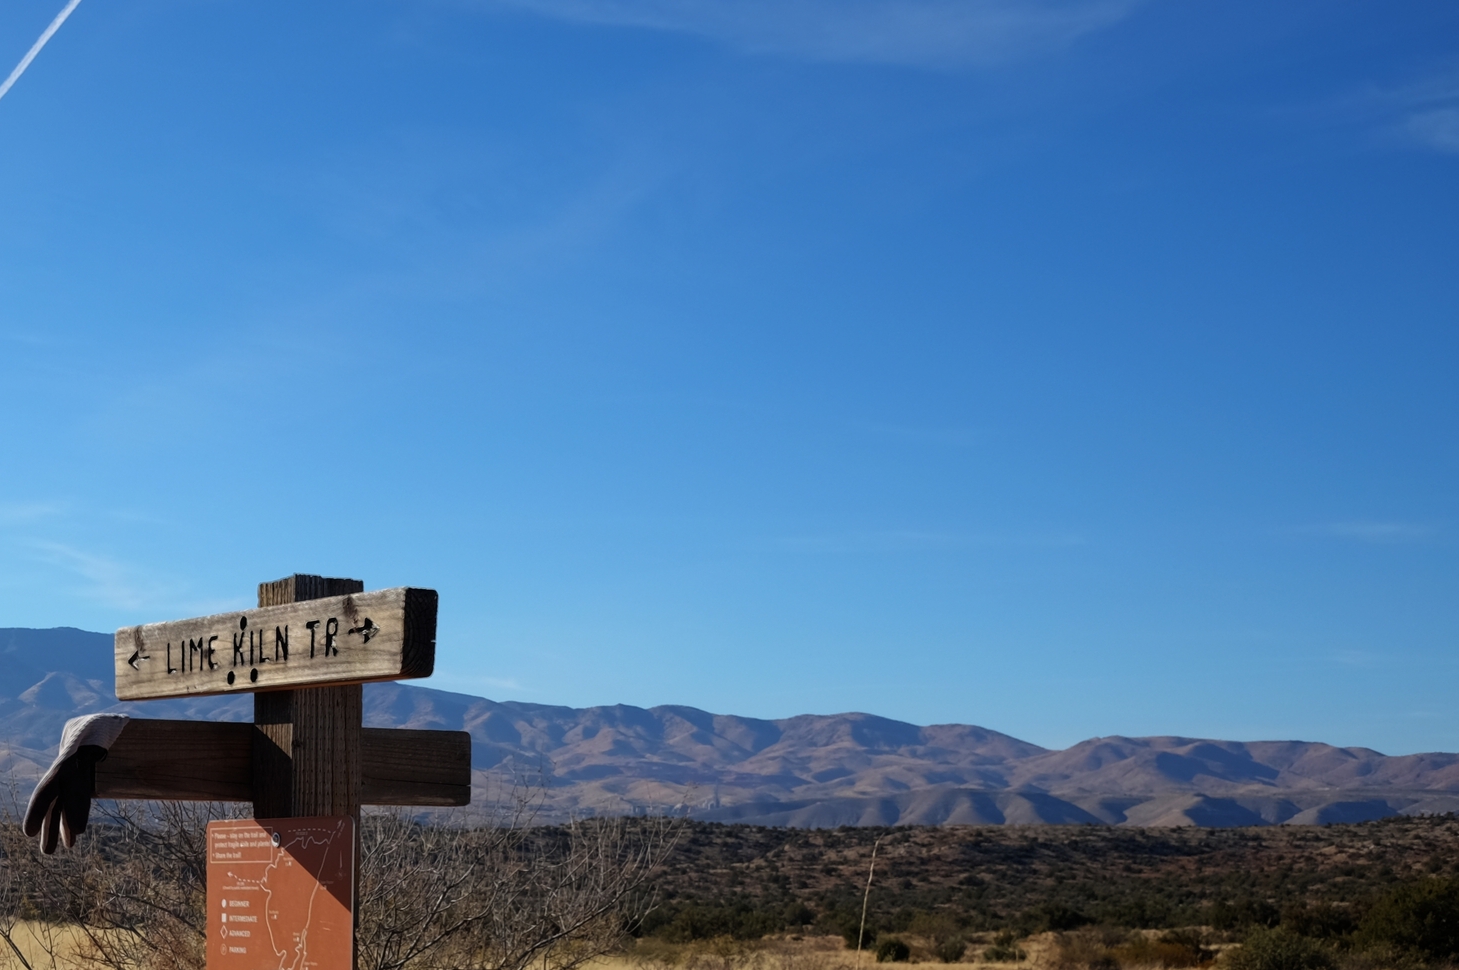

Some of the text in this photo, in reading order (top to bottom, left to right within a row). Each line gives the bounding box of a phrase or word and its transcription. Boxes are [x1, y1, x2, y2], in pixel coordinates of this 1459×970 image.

[167, 617, 339, 674] LIME KILN TR
[229, 900, 249, 908] BEGINNER
[229, 914, 257, 923] INTERMEDIATE
[229, 929, 250, 938] ADVANCED
[229, 946, 247, 954] PARKING
